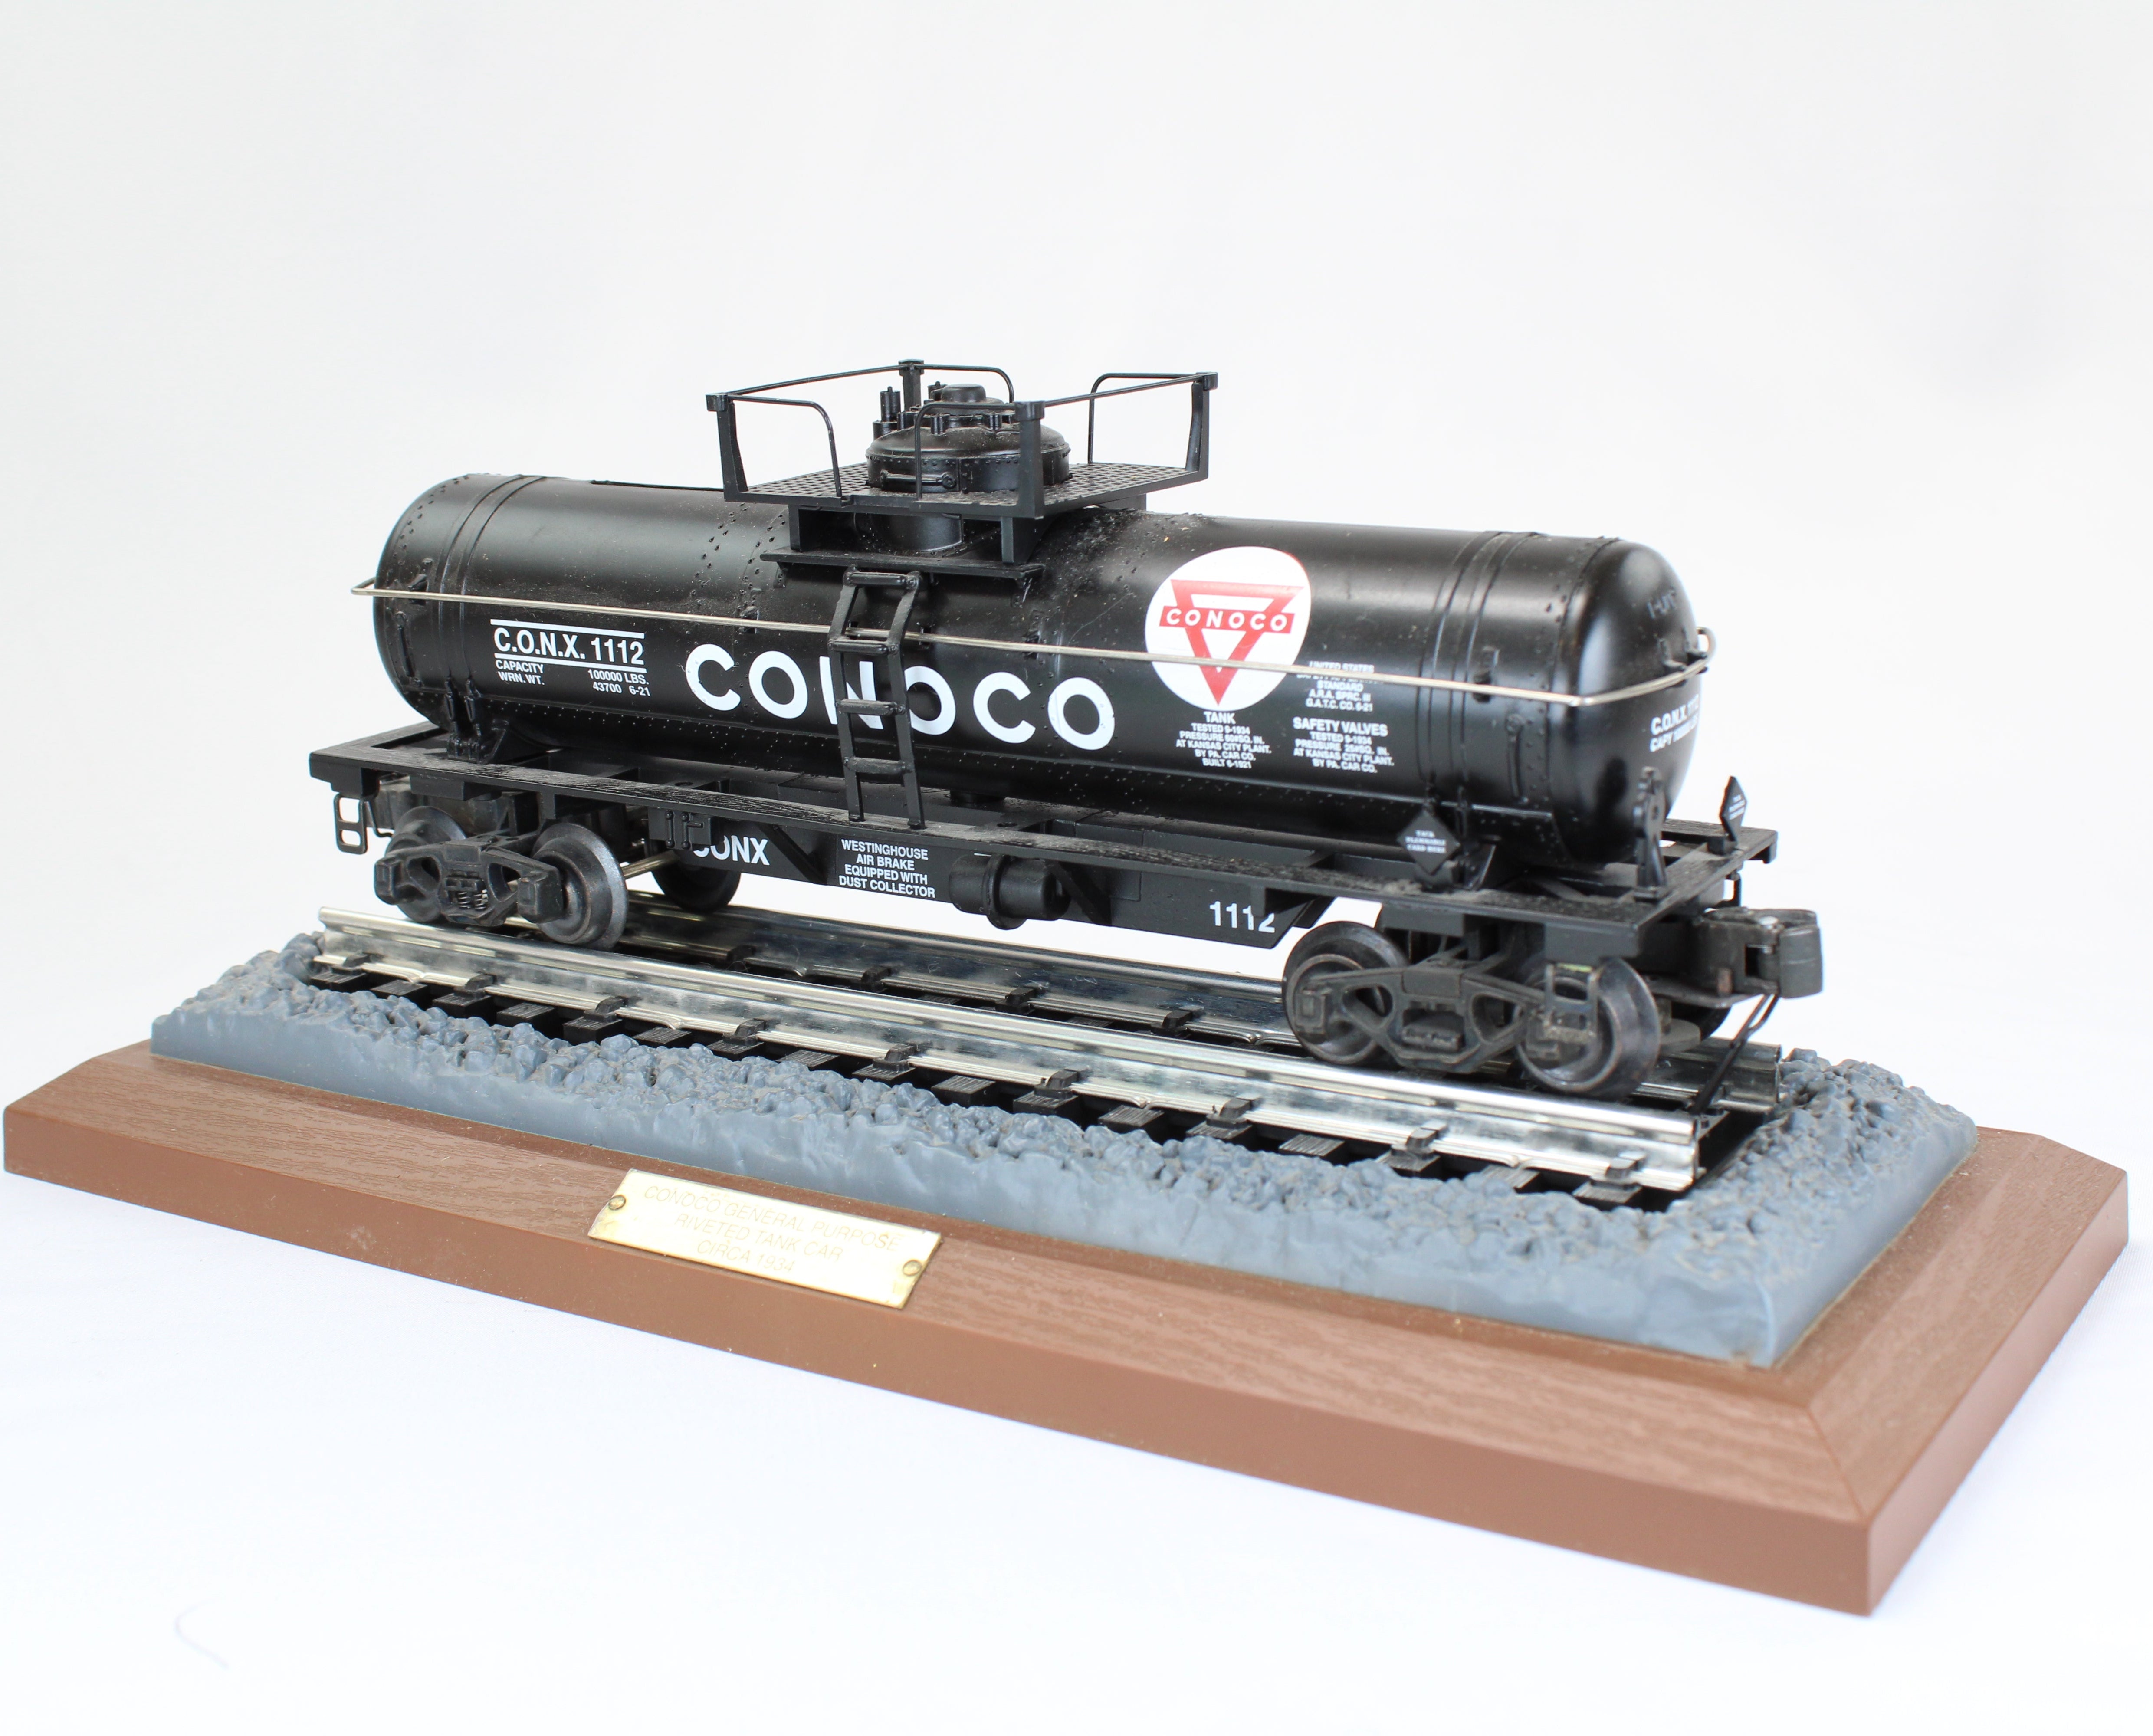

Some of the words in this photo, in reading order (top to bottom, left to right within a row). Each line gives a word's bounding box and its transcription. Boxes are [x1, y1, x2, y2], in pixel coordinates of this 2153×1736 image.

[1166, 609, 1287, 632] CONOCO
[494, 627, 586, 659] C.O.N.X.
[591, 637, 645, 665] 1112
[495, 660, 544, 673] CAPACITY
[588, 669, 623, 683] 100000
[624, 673, 650, 685] LBS.
[498, 671, 526, 684] WRN.
[525, 674, 545, 685] WT.
[593, 681, 622, 693] 43700
[628, 685, 651, 696] 6-21
[1316, 680, 1364, 692] STANDARD
[686, 643, 1115, 751] CONOCO
[1339, 701, 1355, 711] CO.
[1191, 722, 1224, 733] TESTED
[1203, 711, 1236, 725] TANK
[1293, 716, 1340, 732] SAFETY
[1341, 721, 1388, 737] VALVES
[1179, 730, 1224, 742] PRESSURE
[1295, 738, 1342, 752] PRESSURE
[1309, 731, 1343, 742] TESTED
[1176, 739, 1187, 748] AT
[1187, 740, 1222, 750] KANSAS
[1222, 742, 1241, 752] CITY
[1242, 744, 1272, 754] PLANT.
[1195, 749, 1206, 757] BY
[1208, 750, 1221, 759] PA.
[1221, 751, 1240, 760] CAR
[1241, 752, 1256, 761] CO.
[1202, 758, 1225, 767] BUILT
[1293, 748, 1305, 757] AT
[1305, 749, 1341, 761] KANSAS
[1342, 752, 1362, 762] CITY
[1363, 754, 1395, 766] PLANT.
[1312, 758, 1324, 768] BY
[1341, 761, 1361, 771] CAR
[1361, 763, 1378, 773] CO.
[841, 839, 929, 860] WESTINGHOUSE
[856, 853, 874, 866] AIR
[877, 856, 915, 871] BRAKE
[844, 864, 899, 881] EQUIPPED
[900, 871, 928, 885] WITH
[839, 875, 867, 889] DUST
[870, 879, 935, 898] COLLECTOR
[1209, 901, 1275, 933] 1112
[644, 1185, 721, 1212] CONOCO
[724, 1202, 805, 1231] GENERAL
[811, 1221, 899, 1251] PURPOSE
[674, 1213, 750, 1240] RIVETED
[755, 1230, 802, 1252] TANK
[804, 1241, 843, 1261] CAR
[697, 1240, 751, 1263] CIRCA
[757, 1254, 795, 1273] 1934
